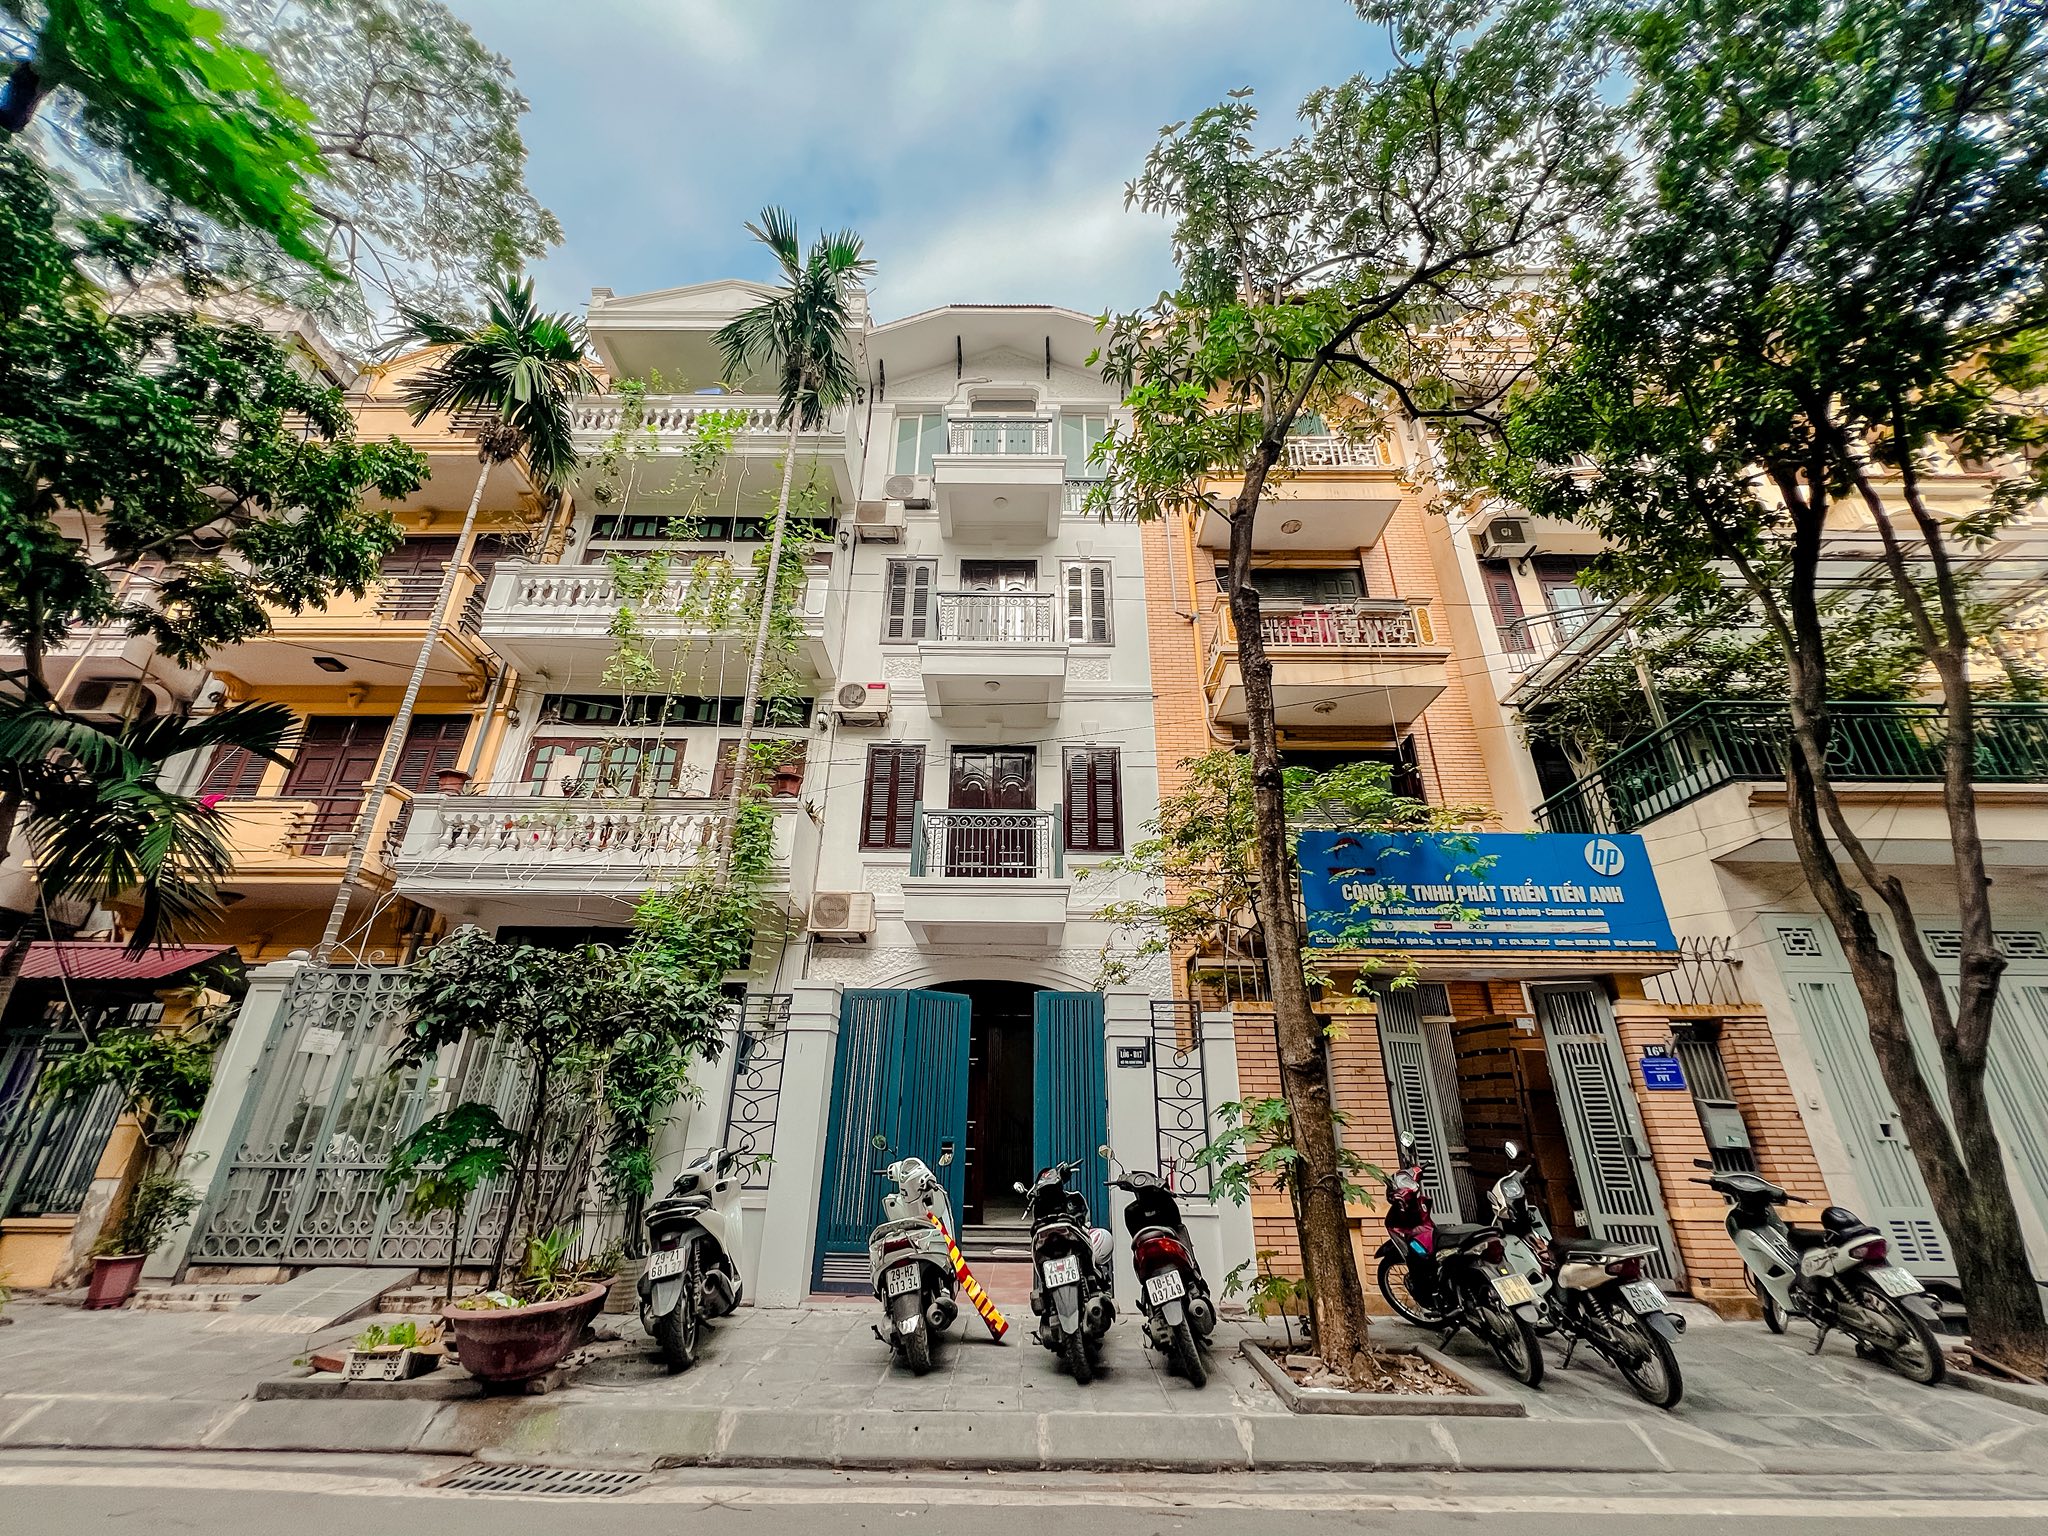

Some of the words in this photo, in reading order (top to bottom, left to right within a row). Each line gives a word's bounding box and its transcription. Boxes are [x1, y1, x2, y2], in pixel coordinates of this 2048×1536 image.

[1591, 839, 1619, 876] hp
[1342, 880, 1385, 902] CÔNG
[1387, 884, 1407, 901] TY
[1411, 885, 1454, 902] TNHH
[1456, 881, 1496, 902] PHÁT
[1500, 878, 1548, 902] TRIỂN
[1549, 880, 1587, 902] TIẾN
[1589, 886, 1624, 903] ANH
[1545, 908, 1575, 916] Camera
[651, 1260, 681, 1278] 681.37
[891, 1265, 914, 1281] 29-H2
[1048, 1269, 1077, 1285] 113.26
[890, 1276, 918, 1294] 013.34
[1152, 1273, 1176, 1290] 18-E1
[1151, 1283, 1182, 1303] 037.49
